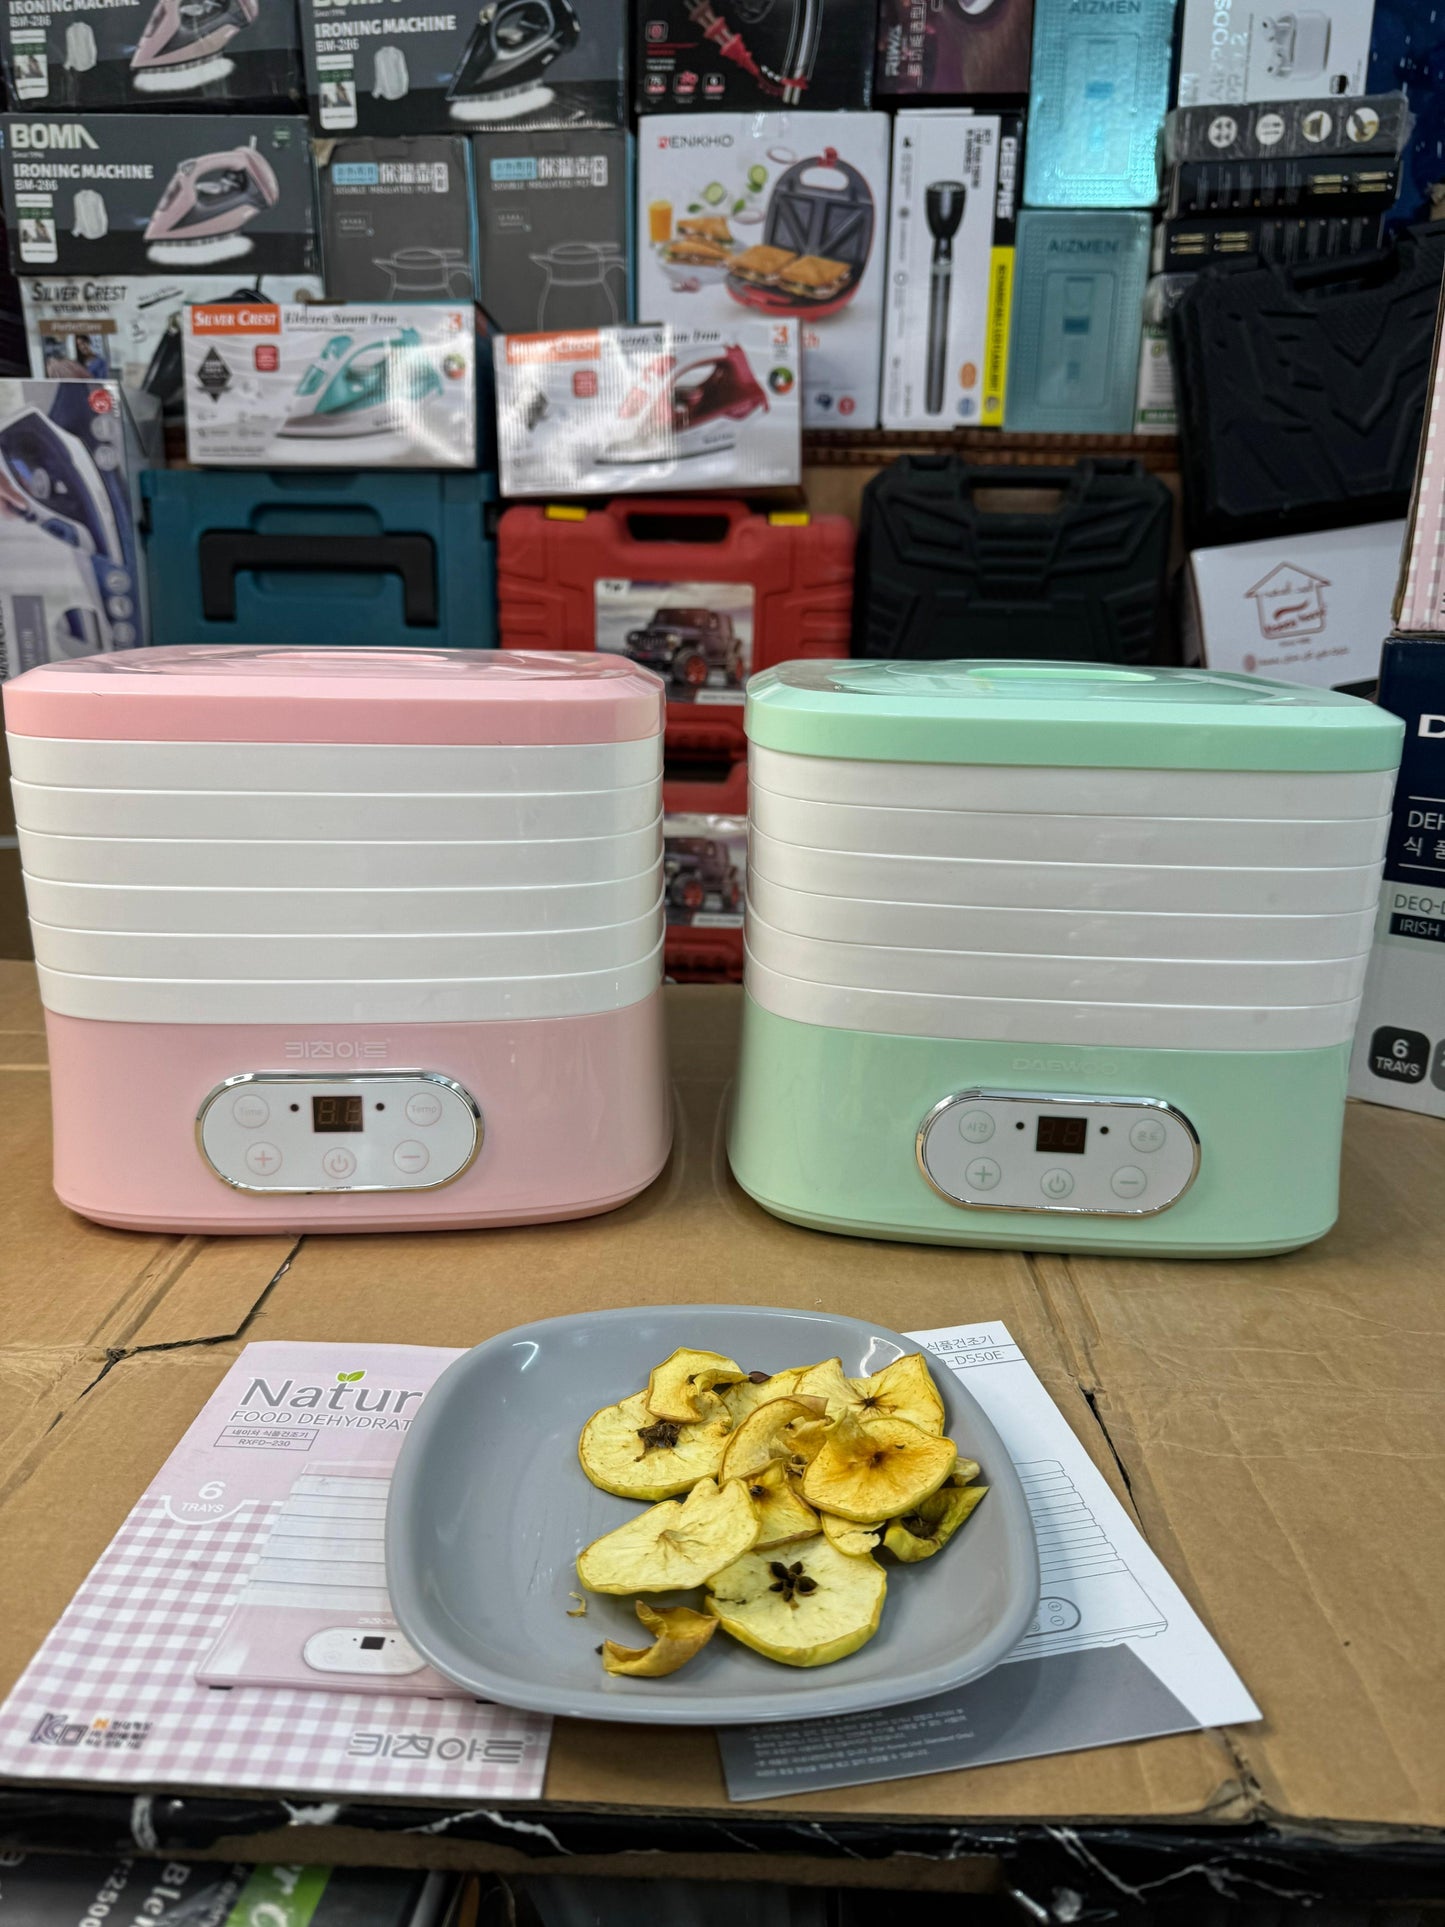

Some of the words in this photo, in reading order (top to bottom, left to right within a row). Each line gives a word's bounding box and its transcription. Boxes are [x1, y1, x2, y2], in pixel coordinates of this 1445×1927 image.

[9, 1, 73, 14] IRONING
[1068, 0, 1142, 15] AIZMEN
[314, 19, 382, 38] IRONING
[383, 14, 457, 34] MACHINE
[10, 123, 100, 149] BOMA
[13, 164, 81, 178] IRONING
[82, 164, 154, 179] MACHINE
[996, 137, 1017, 219] GEEPAS
[1048, 239, 1119, 252] AIZMEN
[32, 282, 79, 301] SILVER
[83, 282, 127, 300] CREST
[194, 311, 235, 326] SILVER
[237, 310, 276, 326] CREST
[773, 325, 789, 345] 3
[1400, 919, 1440, 937] IRISH
[1392, 1038, 1409, 1059] 6
[1376, 1056, 1420, 1077] TRAYS
[410, 1104, 437, 1115] Temp
[926, 1334, 994, 1352] 식품건조기
[240, 1378, 423, 1413] Natur
[231, 1411, 291, 1423] FOOD
[239, 1438, 290, 1447] RXFD-230
[198, 1480, 226, 1500] 6
[181, 1502, 224, 1514] TRAYS
[348, 1732, 524, 1764] 키친아트
